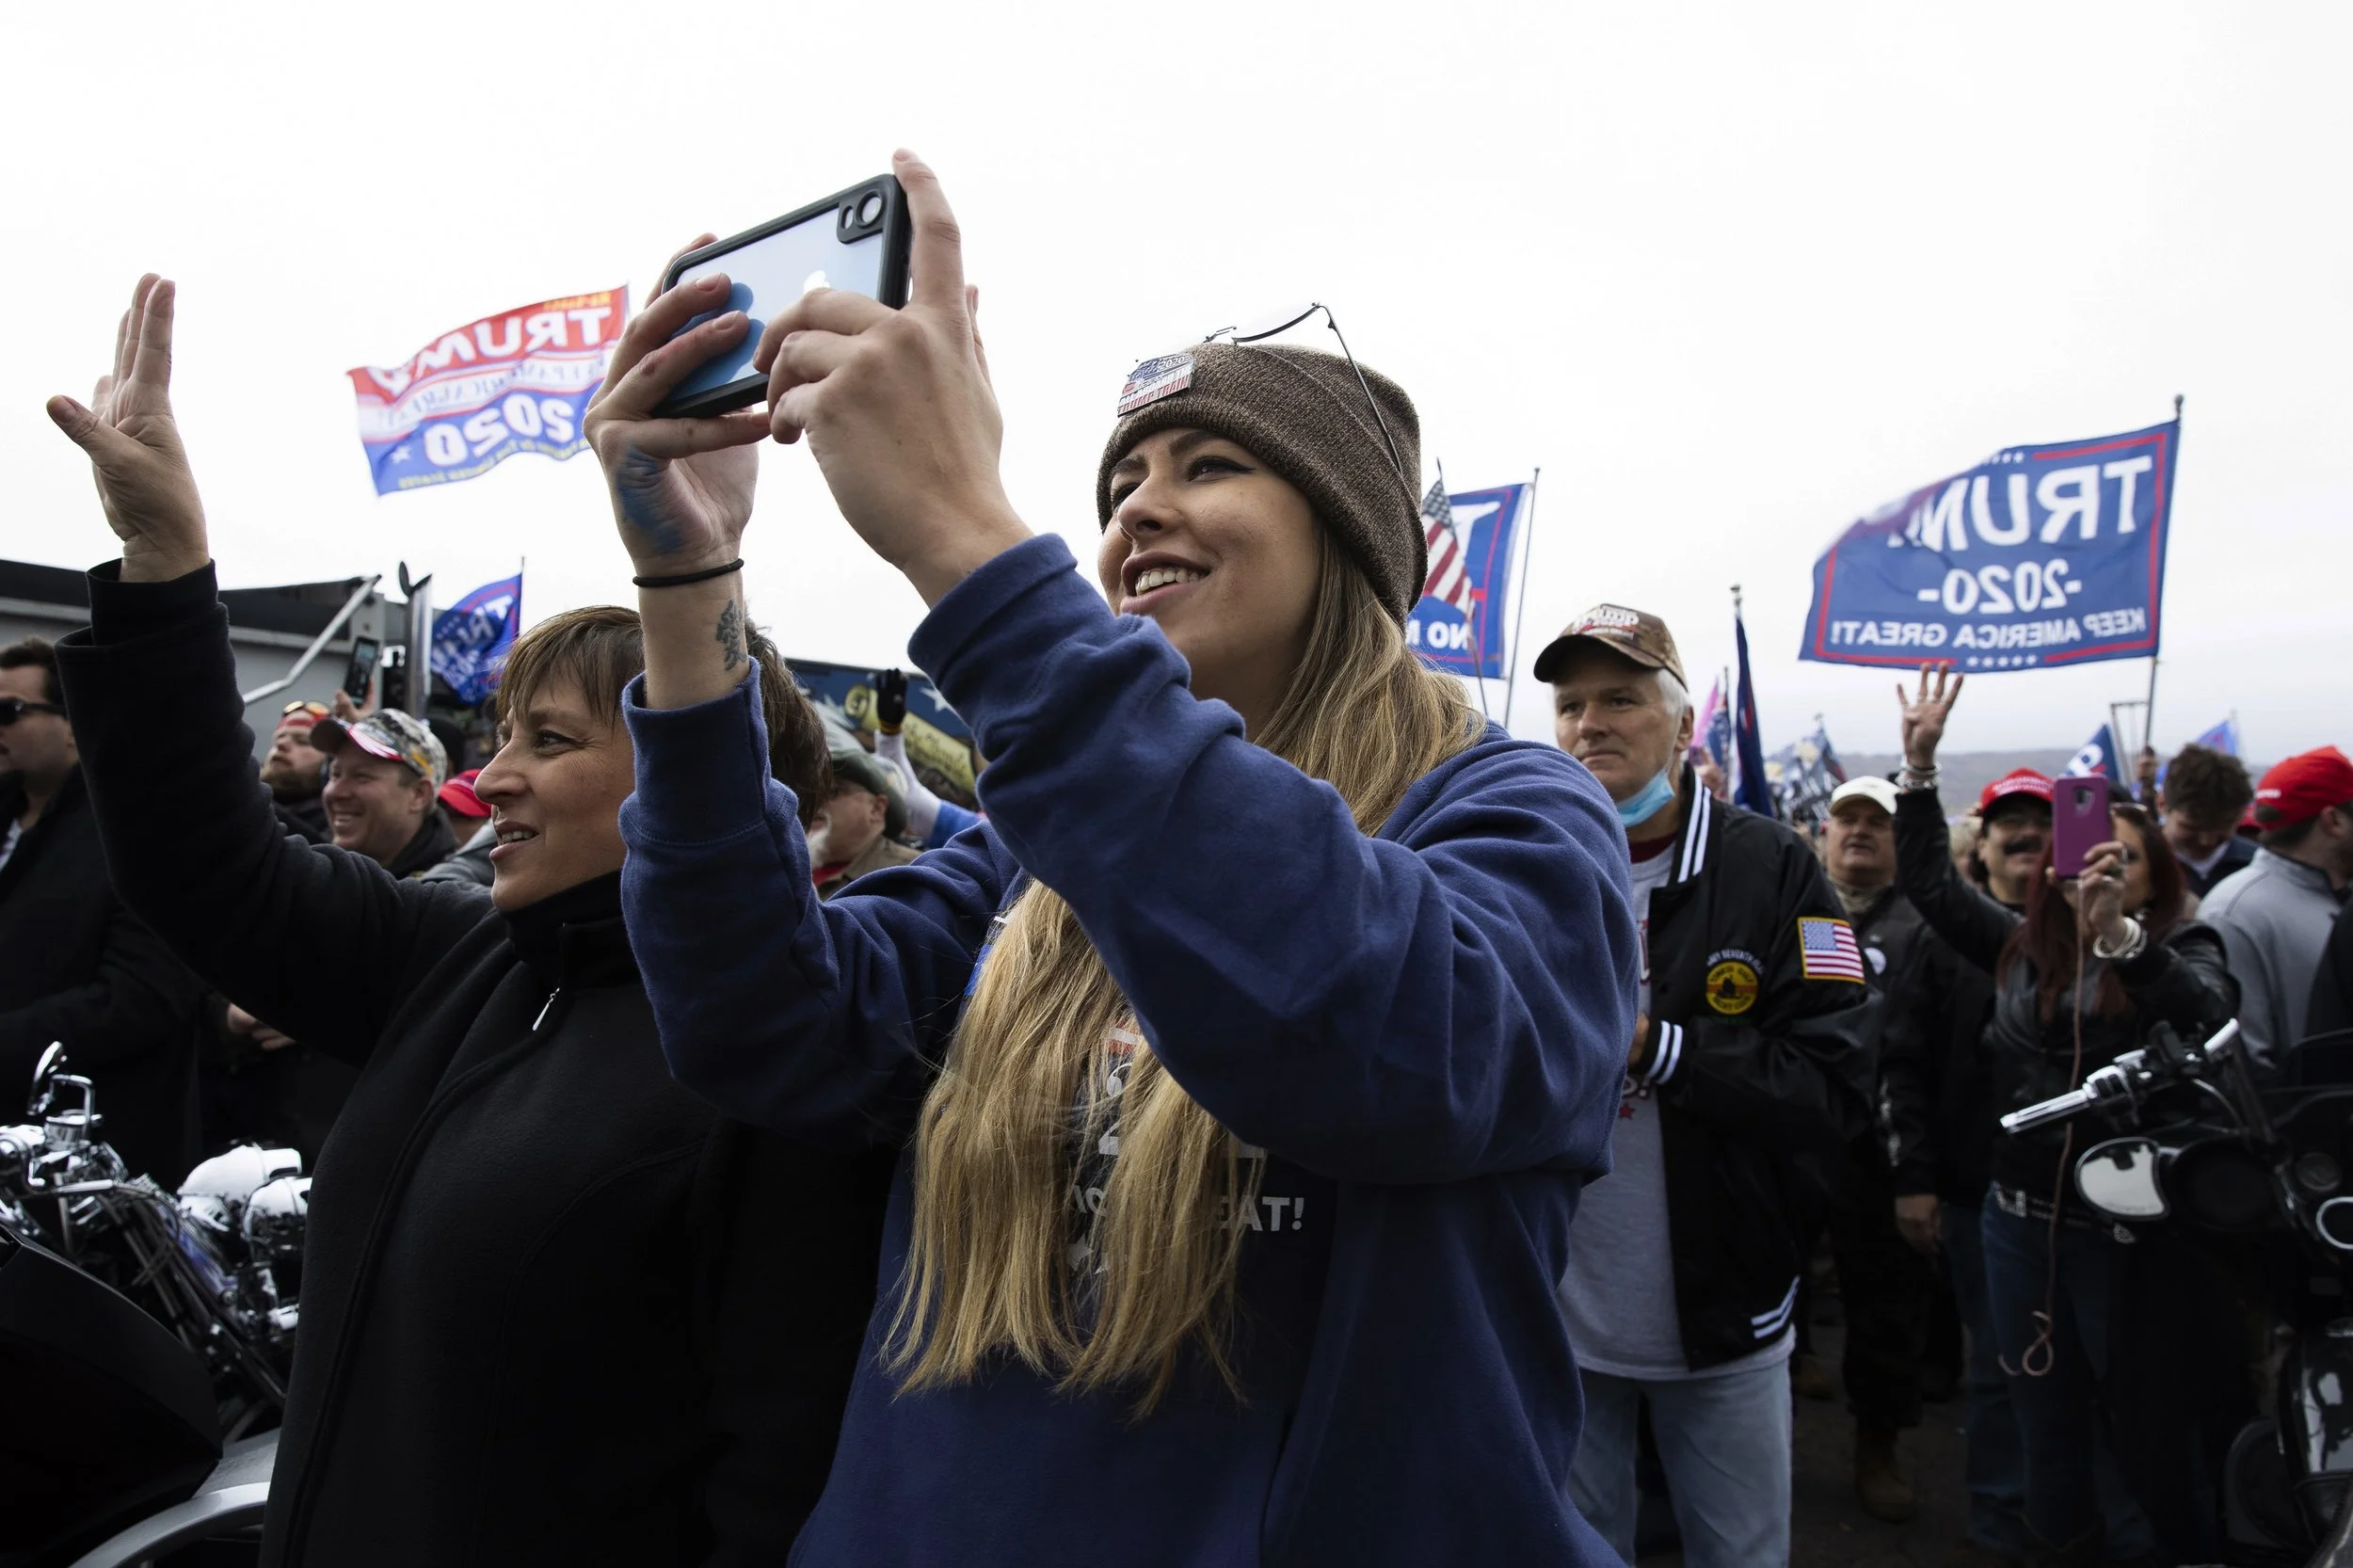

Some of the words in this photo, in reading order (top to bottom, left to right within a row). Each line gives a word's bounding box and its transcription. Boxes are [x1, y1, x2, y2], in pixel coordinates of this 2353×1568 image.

[1159, 357, 1185, 371] 2020
[1117, 391, 1155, 415] TRUMP
[1157, 374, 1190, 401] TRAIN
[1217, 1195, 1305, 1232] EAT!
